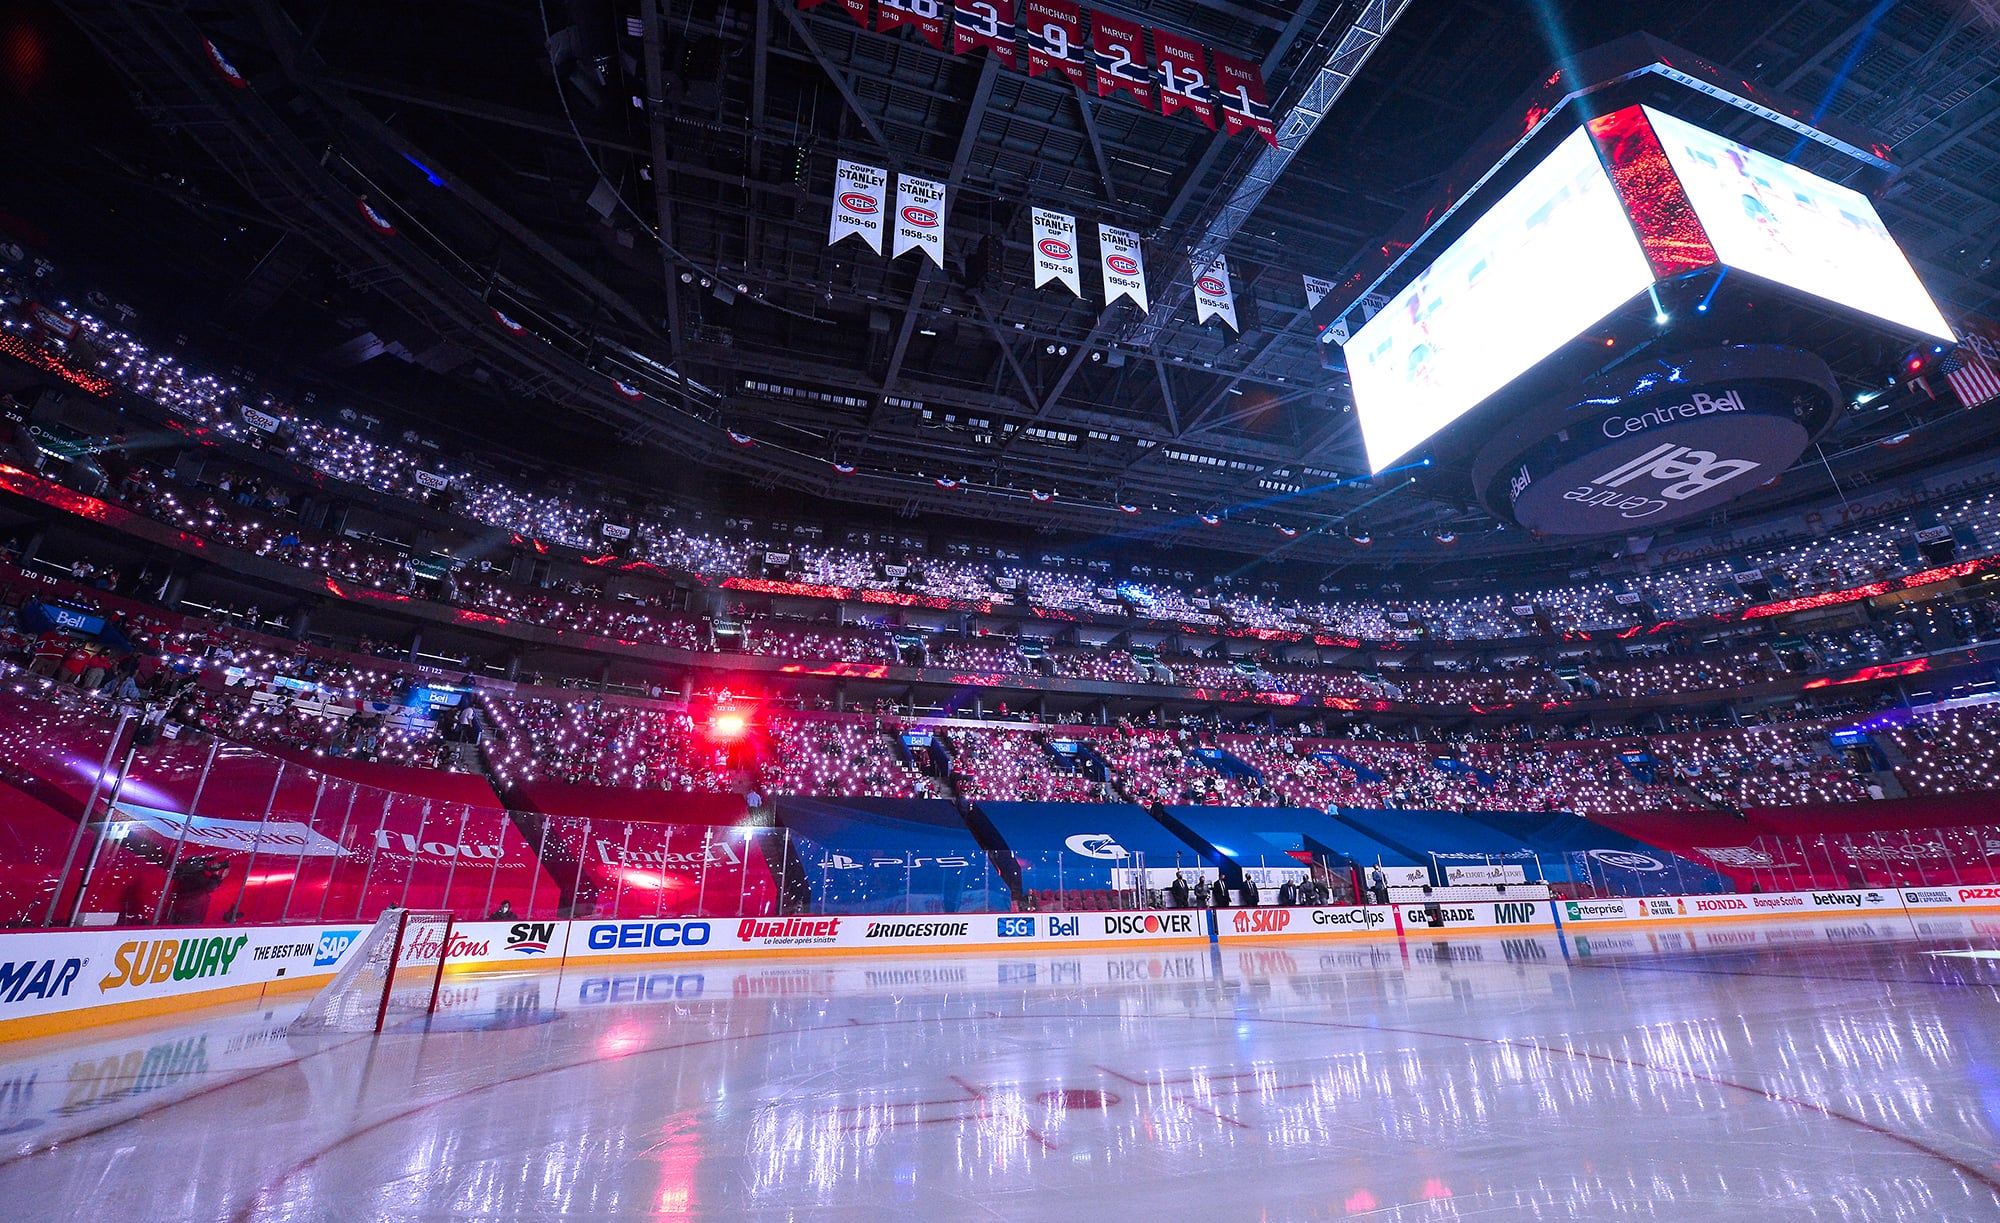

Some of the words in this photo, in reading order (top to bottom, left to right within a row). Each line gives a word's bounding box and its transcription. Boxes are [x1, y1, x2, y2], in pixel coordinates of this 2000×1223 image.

[847, 1, 864, 10] 1937
[1029, 2, 1077, 24] M.RICHARD
[972, 1, 998, 37] 3
[958, 33, 974, 44] 1941
[1043, 23, 1068, 60] 9
[1101, 25, 1134, 42] HARVEY
[1164, 44, 1195, 62] MOORE
[1032, 56, 1048, 67] 1942
[1108, 43, 1133, 81] 2
[1225, 65, 1253, 81] PLANTE
[1100, 76, 1114, 87] 1947
[1160, 60, 1207, 103] 12
[1133, 87, 1148, 97] 1961
[1163, 95, 1178, 105] 1951
[1236, 85, 1255, 120] 1
[1228, 115, 1242, 126] 1952
[838, 168, 885, 187] STANLEY
[850, 164, 875, 175] COUPE
[853, 182, 868, 190] CUP
[910, 178, 934, 189] COUPE
[899, 183, 944, 201] STANLEY
[914, 196, 929, 204] CUP
[838, 214, 877, 229] 1959-60
[1034, 216, 1074, 233] STANLEY
[1043, 212, 1065, 222] COUPE
[900, 228, 938, 243] 1958-59
[1101, 233, 1139, 249] STANLEY
[1109, 228, 1130, 238] COUPE
[1115, 245, 1127, 253] CUP
[1039, 260, 1074, 274] 1957-58
[1108, 276, 1140, 289] 1956-57
[1199, 297, 1230, 310] 1955-56
[5, 411, 23, 423] 220
[244, 407, 275, 428] Coors
[42, 431, 81, 452] Desjardins
[418, 472, 443, 486] Coors
[1590, 442, 1761, 500] Bell
[1562, 486, 1668, 519] Centre
[397, 551, 409, 559] 221
[20, 568, 38, 580] 120
[42, 575, 58, 586] 121
[56, 610, 86, 629] Bell
[418, 665, 429, 673] 121
[431, 667, 443, 675] 122
[911, 736, 924, 745] Bell
[382, 851, 526, 868] flowhydrationcom
[872, 856, 969, 869] PS5
[1697, 899, 1748, 911] HONDA
[1753, 897, 1780, 909] Banque
[1780, 895, 1804, 906] Scotia
[1811, 893, 1862, 907] betway
[1408, 908, 1475, 923] GARADE
[1494, 902, 1535, 924] MNP
[1569, 903, 1624, 917] enterprise
[1005, 919, 1027, 935] 5G
[1049, 916, 1079, 937] Bell
[1104, 915, 1192, 934] DISCOVER
[1251, 909, 1290, 932] SKIP
[507, 923, 555, 944] SN
[587, 922, 711, 949] GEICO
[736, 917, 841, 943] Qualinet
[865, 921, 968, 938] BRIDGESTONE
[773, 937, 793, 945] leader
[794, 936, 812, 945] après
[813, 935, 836, 944] sinistre
[253, 946, 271, 961] THE
[271, 944, 293, 958] BEST
[293, 943, 314, 957] RUN
[317, 936, 349, 961] SAP
[98, 932, 248, 994] SUBWAY
